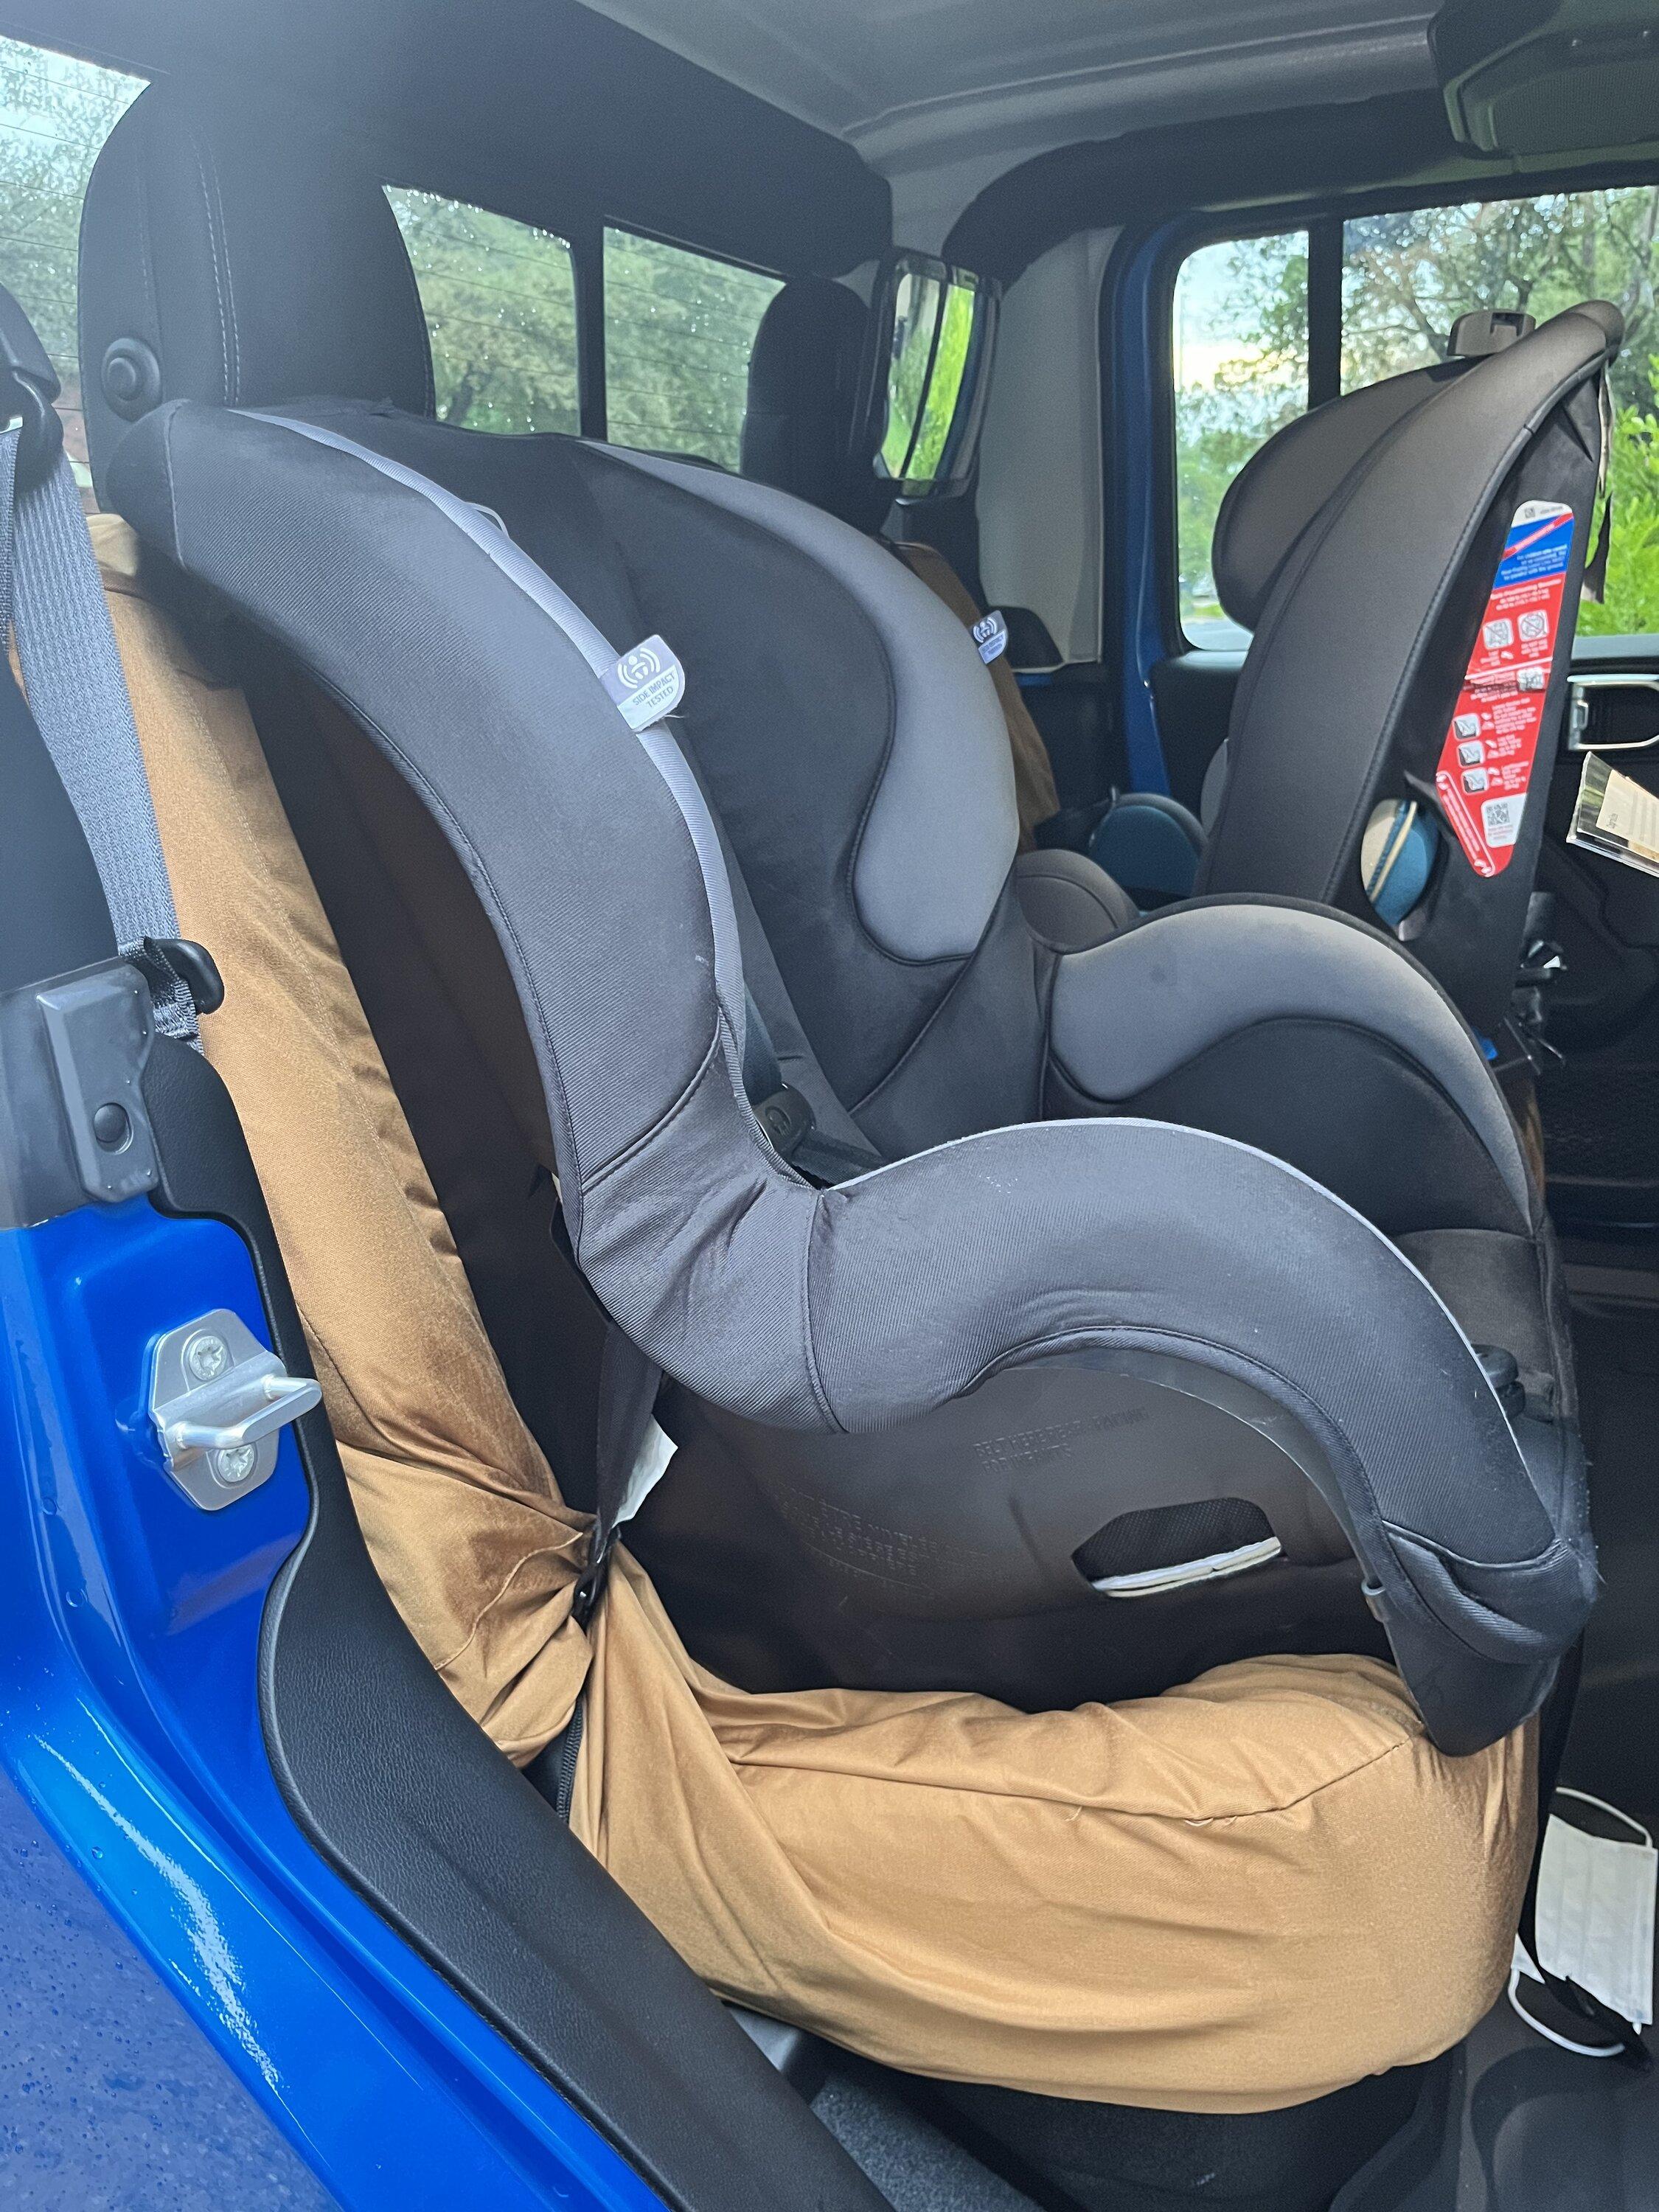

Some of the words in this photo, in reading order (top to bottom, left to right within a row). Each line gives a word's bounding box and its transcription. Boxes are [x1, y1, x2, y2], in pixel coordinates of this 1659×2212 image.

[633, 689, 650, 706] SIDE
[650, 672, 675, 695] IMPACT
[646, 686, 674, 708] TESTED
